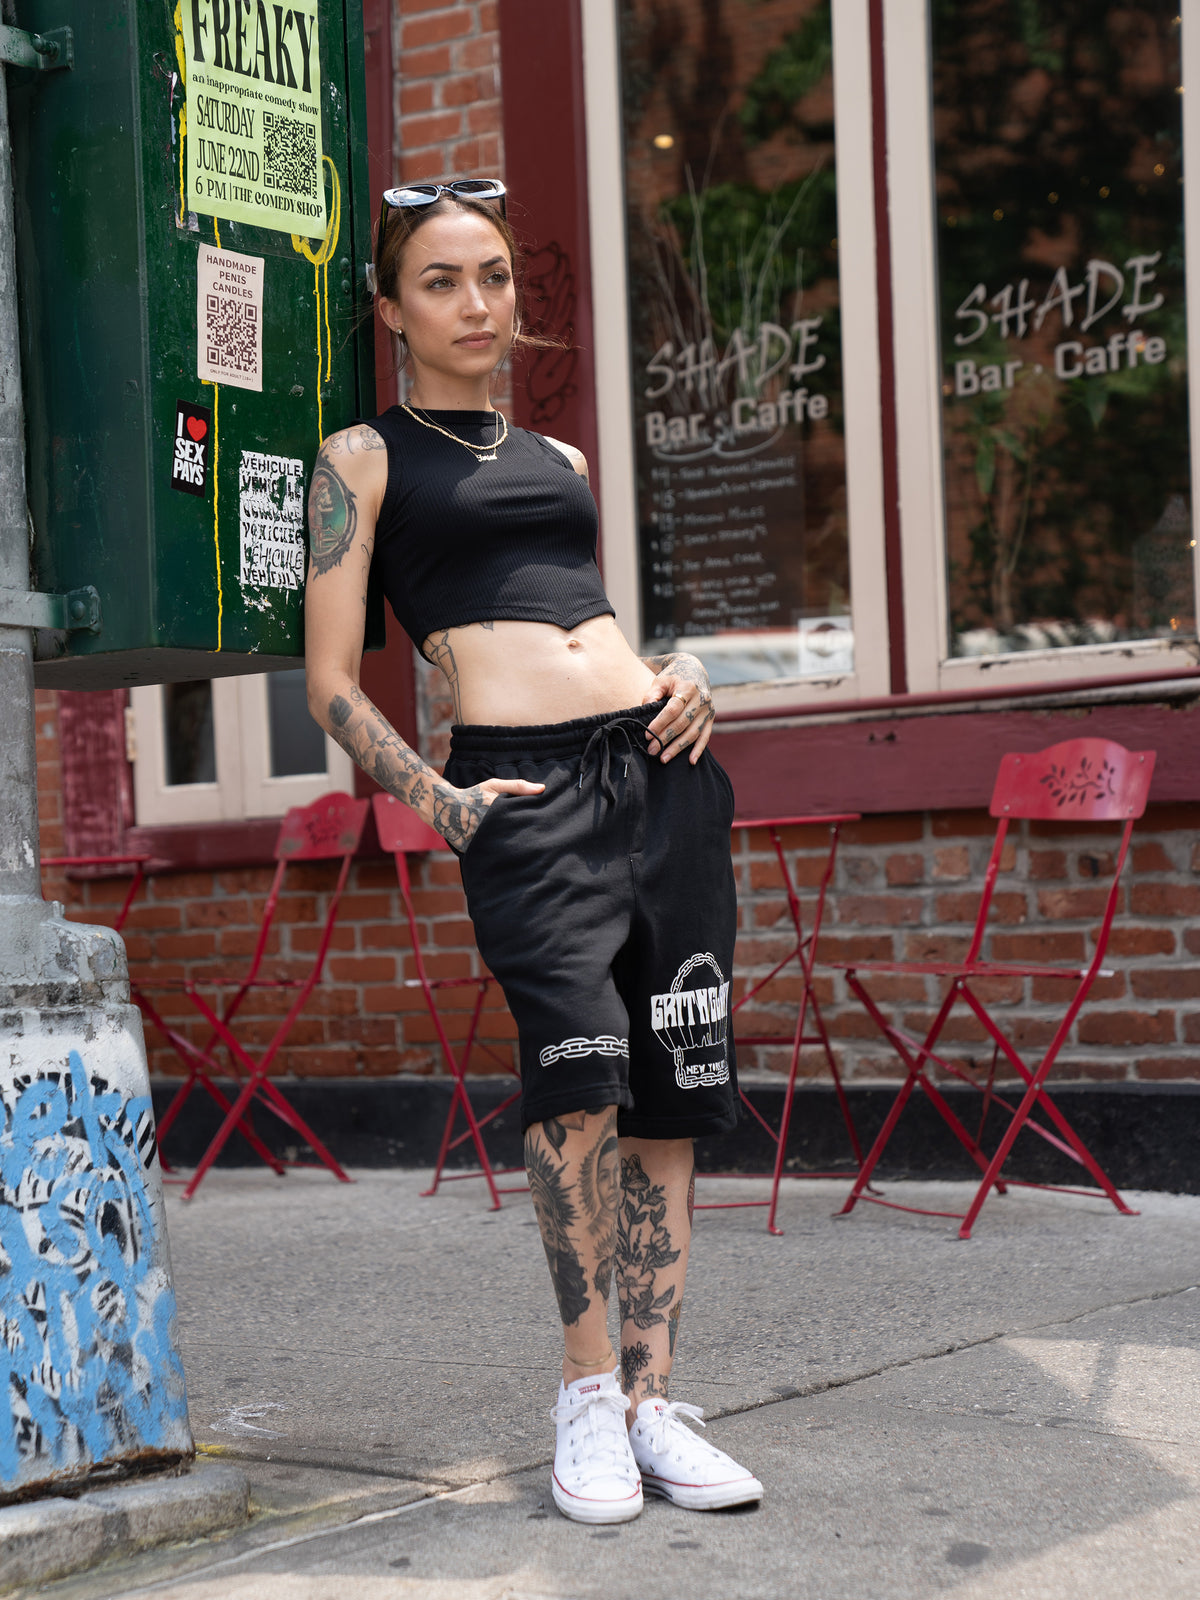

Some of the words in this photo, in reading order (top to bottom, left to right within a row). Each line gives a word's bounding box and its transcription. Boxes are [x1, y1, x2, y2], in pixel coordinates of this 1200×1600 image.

[191, 0, 315, 93] FREAKY
[192, 72, 205, 84] an
[206, 74, 263, 101] inappropriate
[264, 92, 297, 114] comedy
[298, 101, 319, 116] show
[196, 94, 255, 139] SATURDAY
[197, 138, 227, 174] JUNE
[228, 146, 260, 182] 22ND
[195, 175, 203, 195] 6
[206, 178, 227, 201] PM
[232, 185, 253, 204] THE
[254, 191, 297, 213] COMEDY
[296, 203, 323, 218] SHOP
[206, 254, 257, 275] HANDMADE
[219, 271, 247, 285] PENIS
[212, 281, 253, 299] CANDLES
[954, 250, 1165, 346] SHADE
[644, 315, 827, 399] SHADE
[955, 359, 1023, 397] Bar
[1054, 329, 1166, 380] Caffe
[177, 411, 184, 437] I
[645, 411, 706, 446] Bar
[731, 387, 829, 431] Caffe
[173, 457, 204, 487] PAYS
[175, 437, 205, 466] SEX
[686, 1063, 706, 1075] NEW
